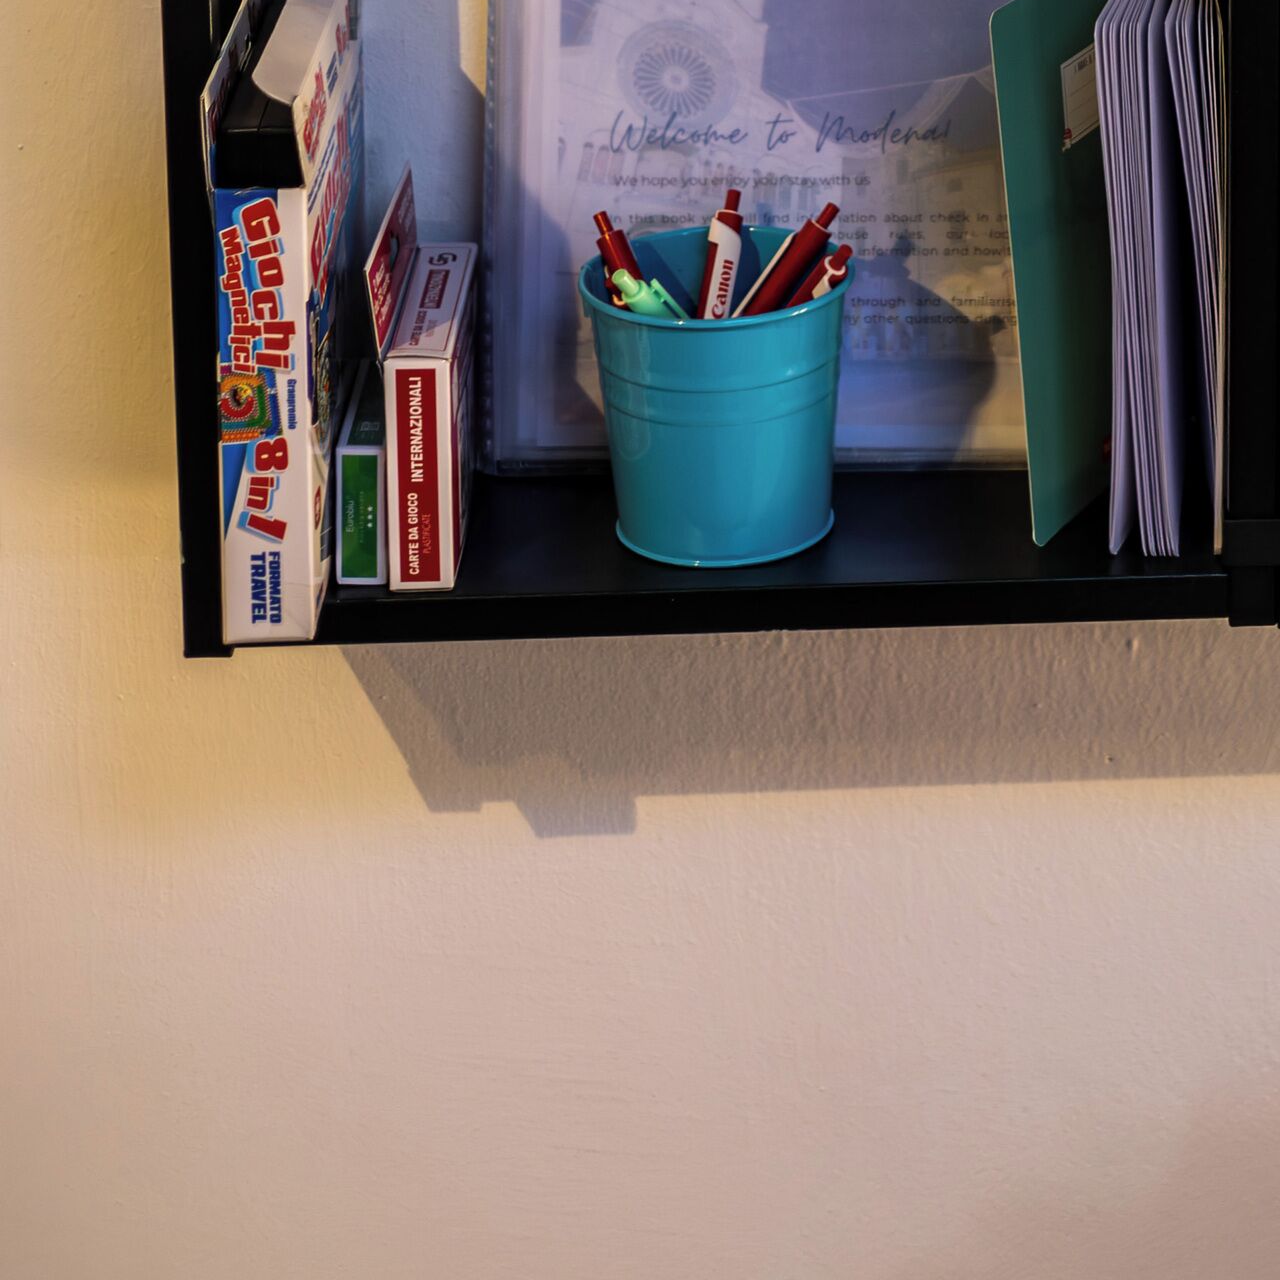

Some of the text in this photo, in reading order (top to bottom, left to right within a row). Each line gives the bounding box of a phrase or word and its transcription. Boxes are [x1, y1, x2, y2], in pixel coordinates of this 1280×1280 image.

[610, 109, 952, 154] Welcome to Modena!
[615, 173, 870, 190] We hope you enjoy your stay with us
[628, 213, 655, 224] this
[661, 213, 697, 224] book
[763, 212, 791, 224] find
[884, 212, 922, 224] about
[929, 212, 969, 224] check
[976, 212, 989, 224] in
[857, 245, 941, 257] information
[943, 245, 969, 257] and
[219, 225, 264, 375] Magnetici
[241, 197, 296, 371] Giochi
[711, 259, 734, 319] Canon
[851, 295, 941, 308] through and
[864, 313, 900, 325] other
[905, 314, 969, 326] questions
[408, 375, 425, 483] INTERNAZIONALI
[254, 437, 289, 472] 8
[246, 476, 275, 511] in
[406, 492, 420, 575] CARTE DA GIOCO
[420, 513, 432, 555] PLASTIFICATE
[250, 552, 268, 624] TRAVEL
[268, 551, 283, 624] FORMATO
